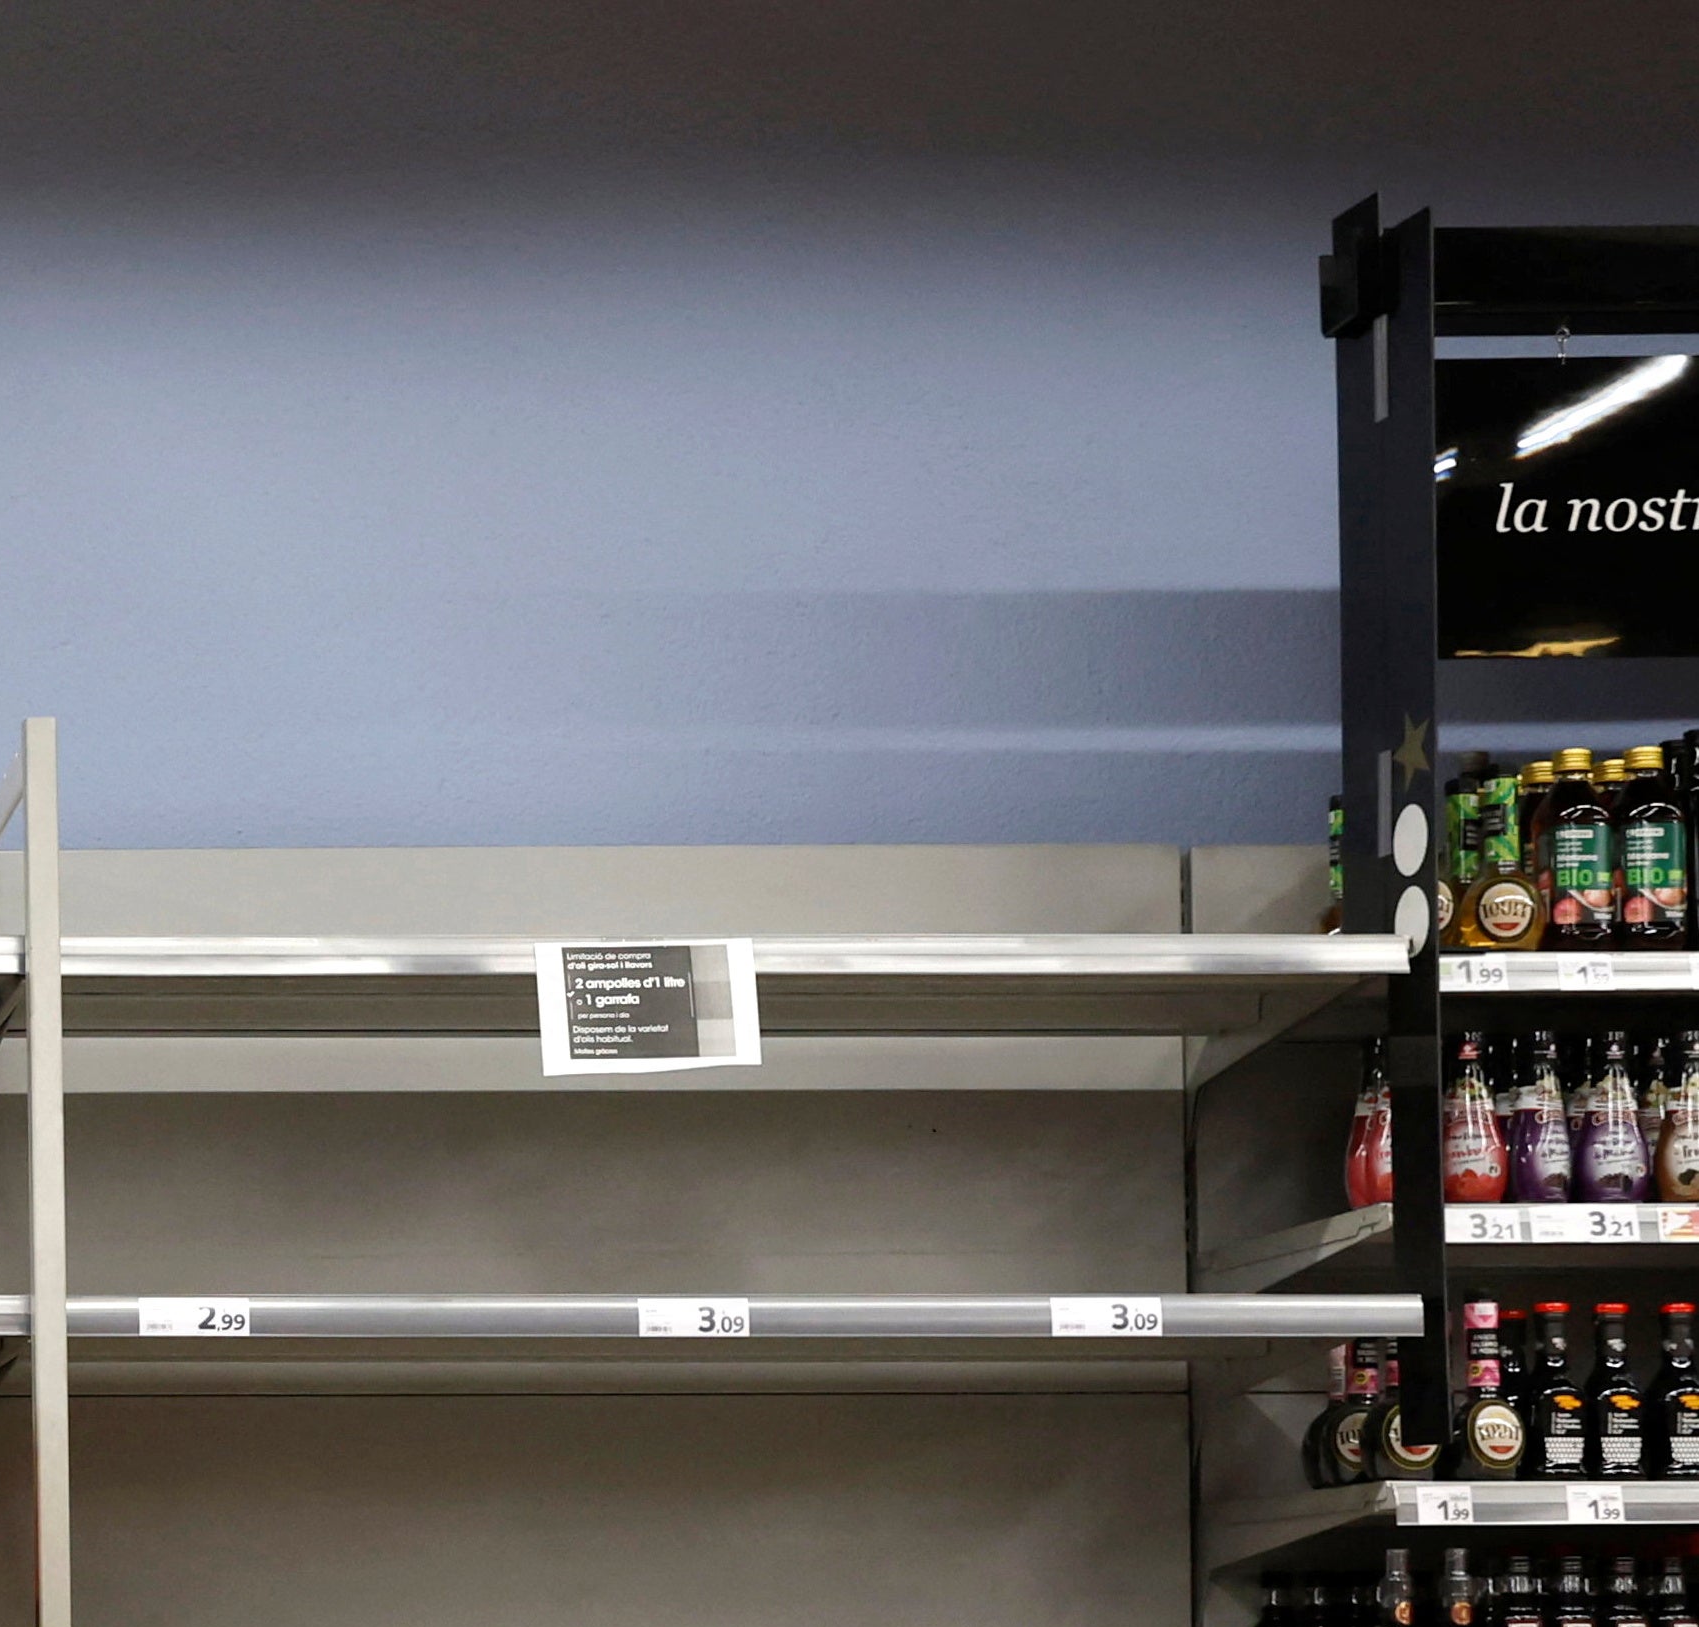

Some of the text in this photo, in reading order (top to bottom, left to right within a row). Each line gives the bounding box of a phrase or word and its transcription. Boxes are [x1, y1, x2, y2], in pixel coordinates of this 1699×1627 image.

[1495, 483, 1548, 533] la
[575, 978, 584, 989] 2
[585, 994, 591, 1005] 1
